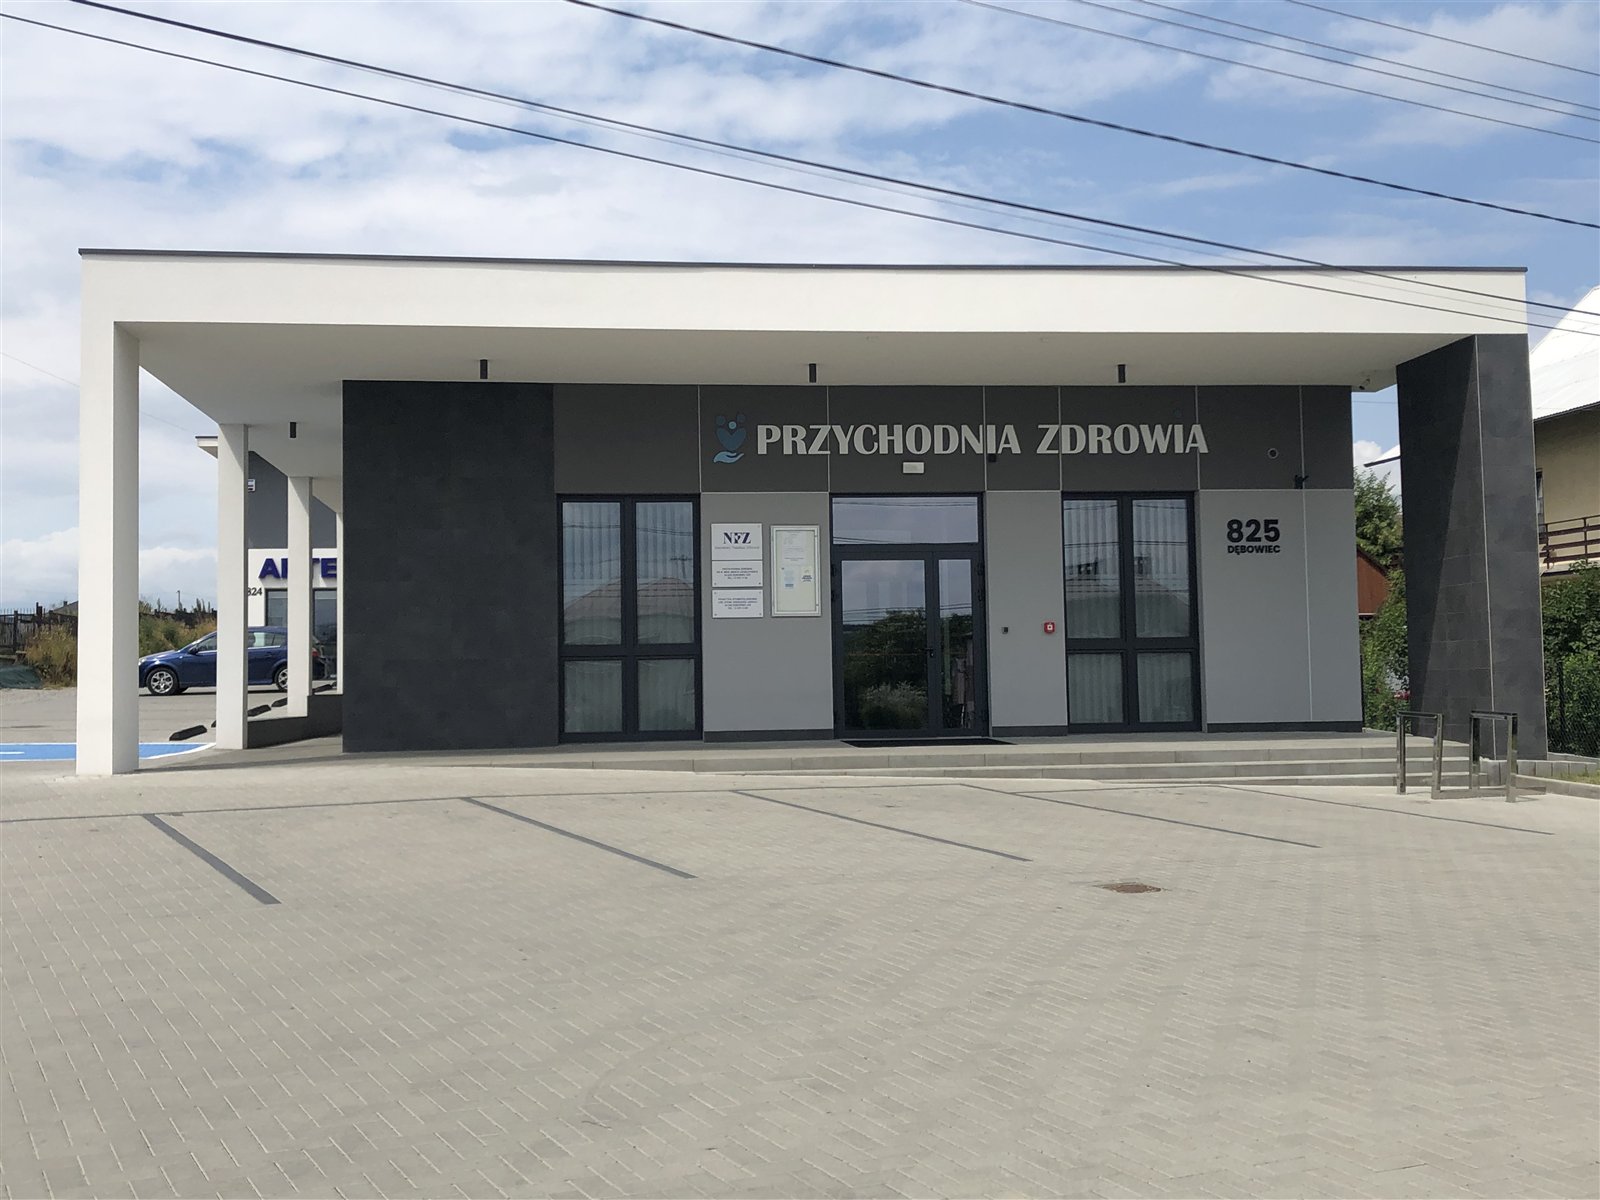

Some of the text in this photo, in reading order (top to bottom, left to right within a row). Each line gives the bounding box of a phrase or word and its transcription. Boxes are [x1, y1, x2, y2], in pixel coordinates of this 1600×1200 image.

[757, 423, 1209, 455] PRZYCHODNIA ZDROWIA
[723, 532, 751, 545] NFZ
[1226, 519, 1280, 543] 825
[1227, 544, 1280, 555] DĘBOWIEC
